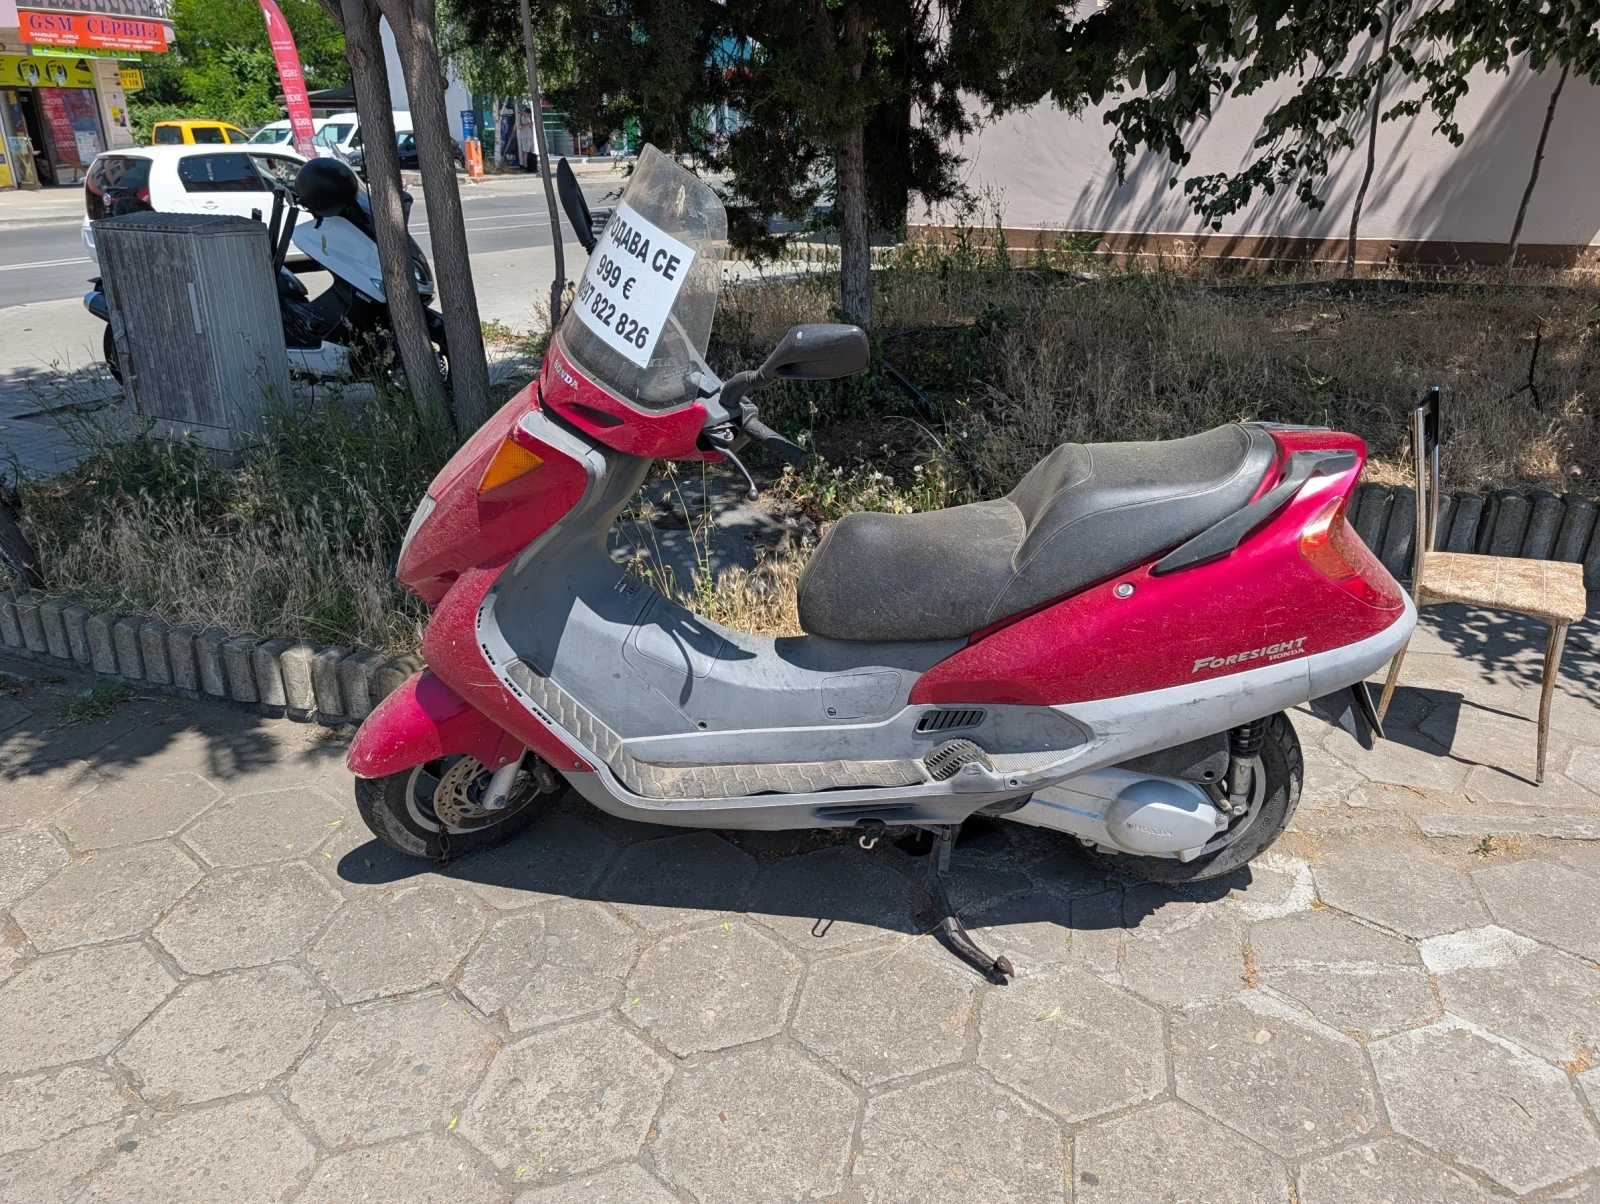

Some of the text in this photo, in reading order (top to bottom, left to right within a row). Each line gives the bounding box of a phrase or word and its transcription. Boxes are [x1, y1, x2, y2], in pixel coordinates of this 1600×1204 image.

[29, 14, 157, 38] GSM СЕРВИЗ
[596, 254, 637, 300] 999 €
[652, 249, 681, 281] СЕ
[590, 292, 617, 327] 822
[615, 313, 650, 349] 826
[553, 360, 579, 391] HONDA
[1191, 636, 1308, 674] FORESIGHT
[1269, 648, 1306, 661] HONDA
